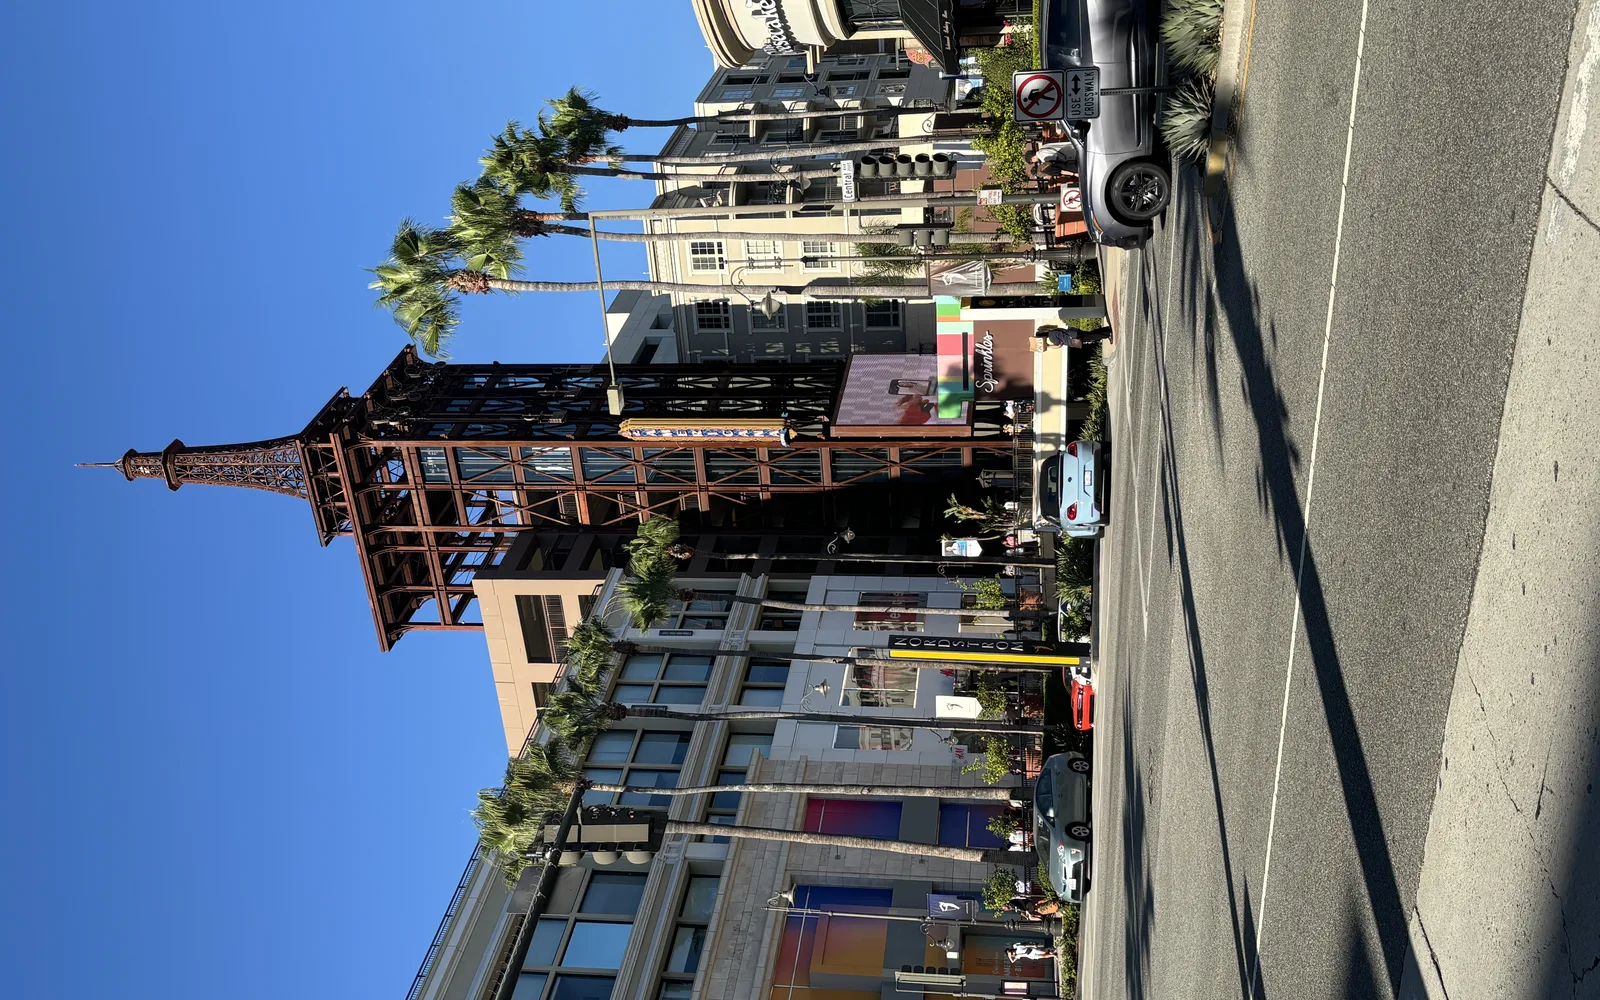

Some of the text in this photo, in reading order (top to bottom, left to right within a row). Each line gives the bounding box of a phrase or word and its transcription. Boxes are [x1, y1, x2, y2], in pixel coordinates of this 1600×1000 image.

[1084, 71, 1095, 116] CROSSWALK
[1071, 97, 1081, 116] USE
[843, 173, 853, 199] Central
[975, 330, 999, 393] Sprinkles
[645, 429, 779, 438] AMERICANA
[894, 637, 1024, 651] NORDSTROM
